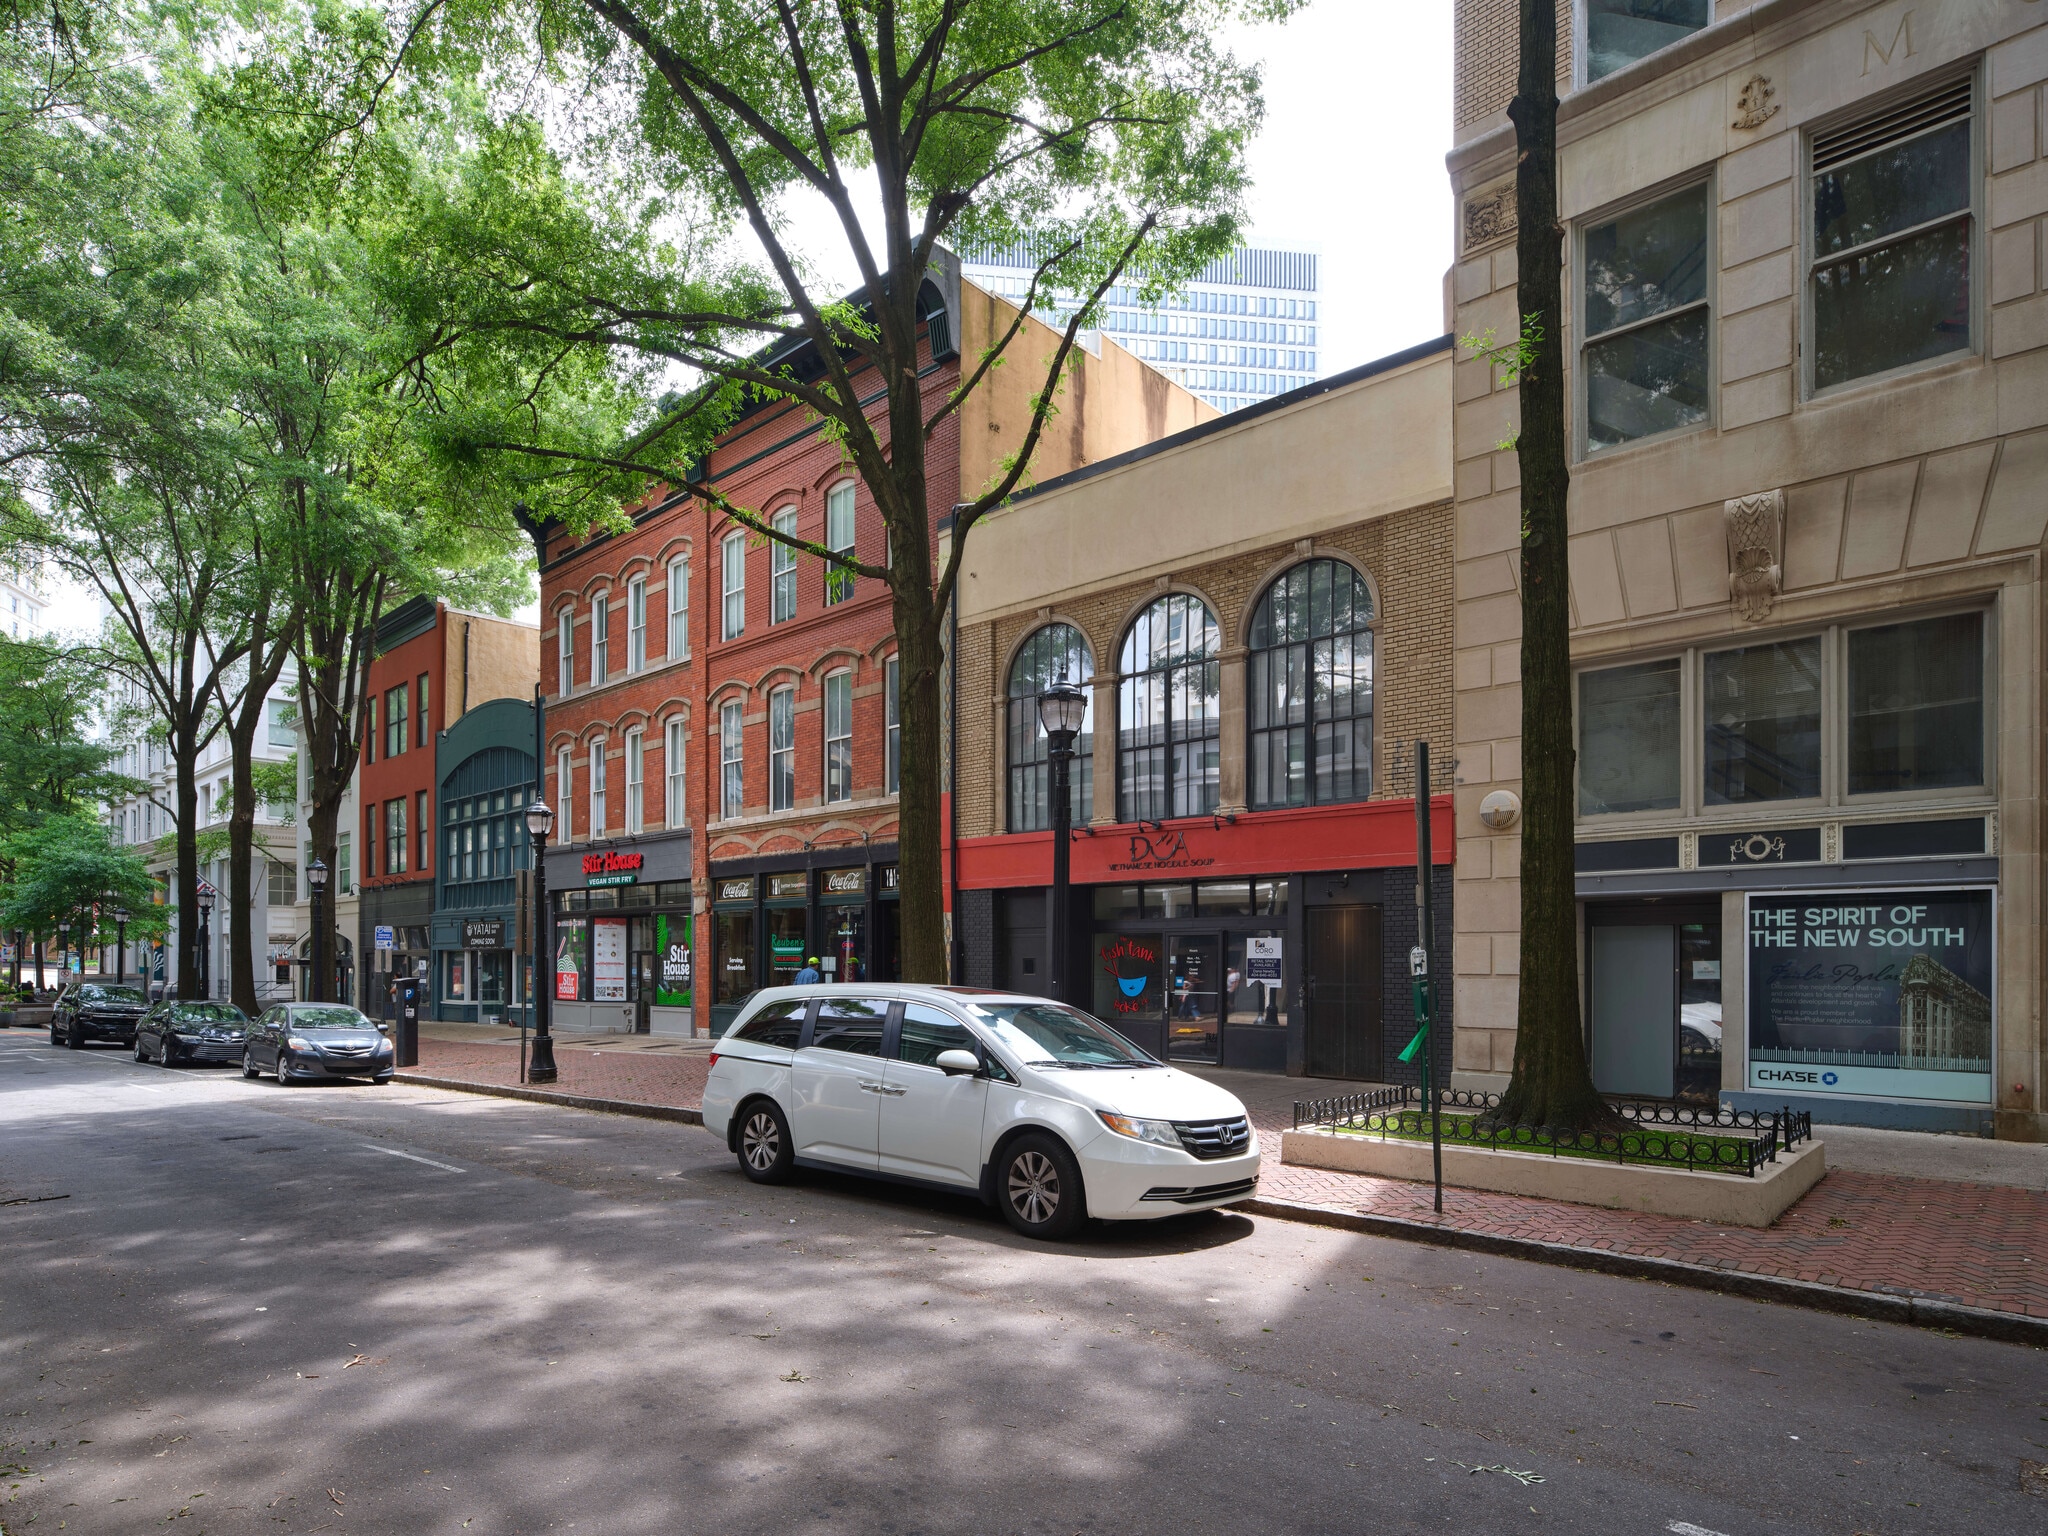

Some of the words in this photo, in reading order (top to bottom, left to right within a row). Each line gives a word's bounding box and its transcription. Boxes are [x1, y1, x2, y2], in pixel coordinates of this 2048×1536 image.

[1859, 9, 1918, 78] M
[582, 853, 602, 874] Stir
[604, 851, 642, 871] House
[1109, 863, 1153, 871] VIETNAMESE
[1154, 861, 1188, 869] NOODLE
[1190, 858, 1214, 866] SOUP
[621, 875, 632, 883] FRY
[1750, 909, 1797, 927] THE
[1804, 906, 1882, 927] SPIRIT
[1890, 905, 1927, 925] OF
[473, 923, 490, 935] YATAI
[771, 933, 805, 947] Reuben's
[1750, 930, 1797, 947] THE
[1804, 928, 1860, 947] NEW
[1868, 927, 1965, 947] SOUTH
[670, 944, 689, 963] Stir
[663, 960, 690, 975] House
[405, 989, 412, 998] P
[1798, 998, 1839, 1006] development
[1758, 1069, 1818, 1083] CHASE
